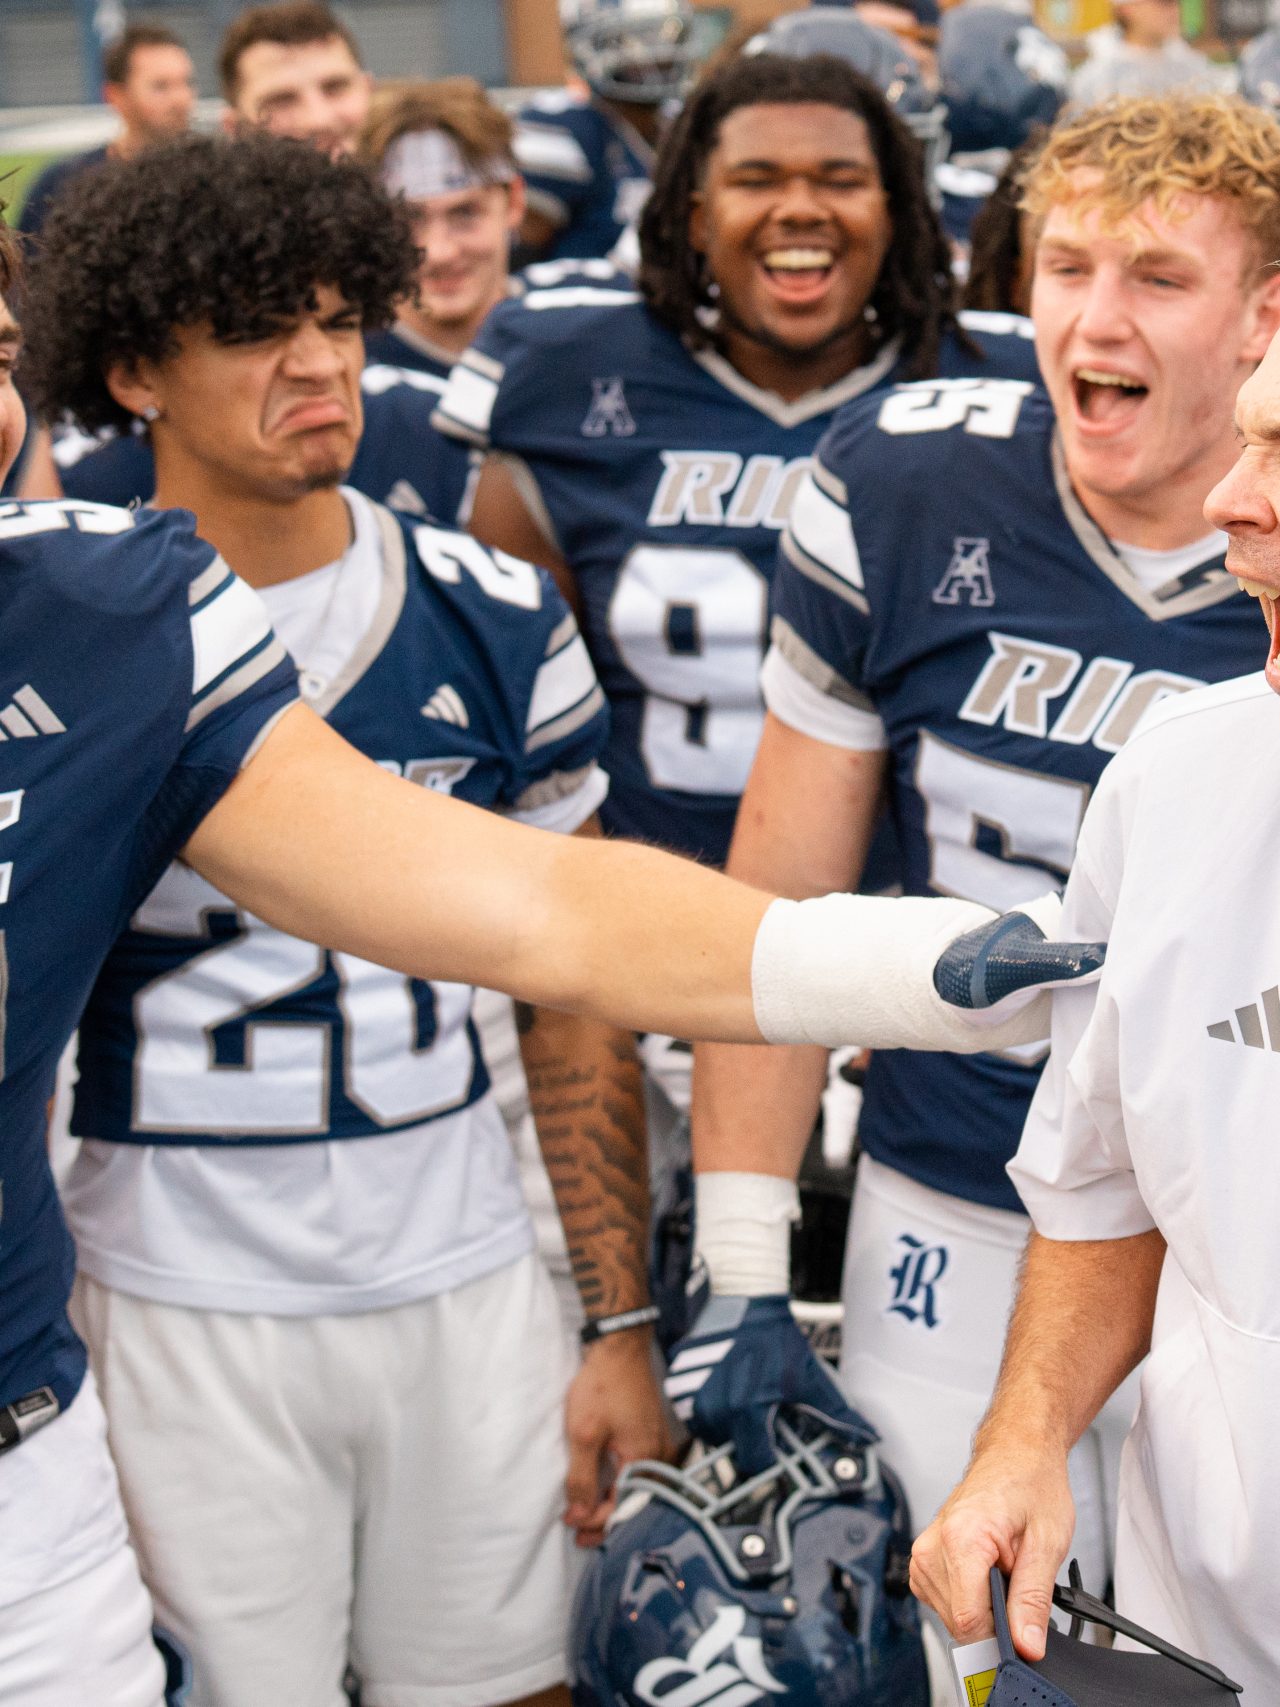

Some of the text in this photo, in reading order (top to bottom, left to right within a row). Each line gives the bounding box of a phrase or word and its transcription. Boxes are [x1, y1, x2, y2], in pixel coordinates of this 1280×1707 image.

[413, 525, 542, 612] 2
[932, 537, 996, 607] A
[608, 543, 769, 797] 9
[886, 1233, 948, 1329] R
